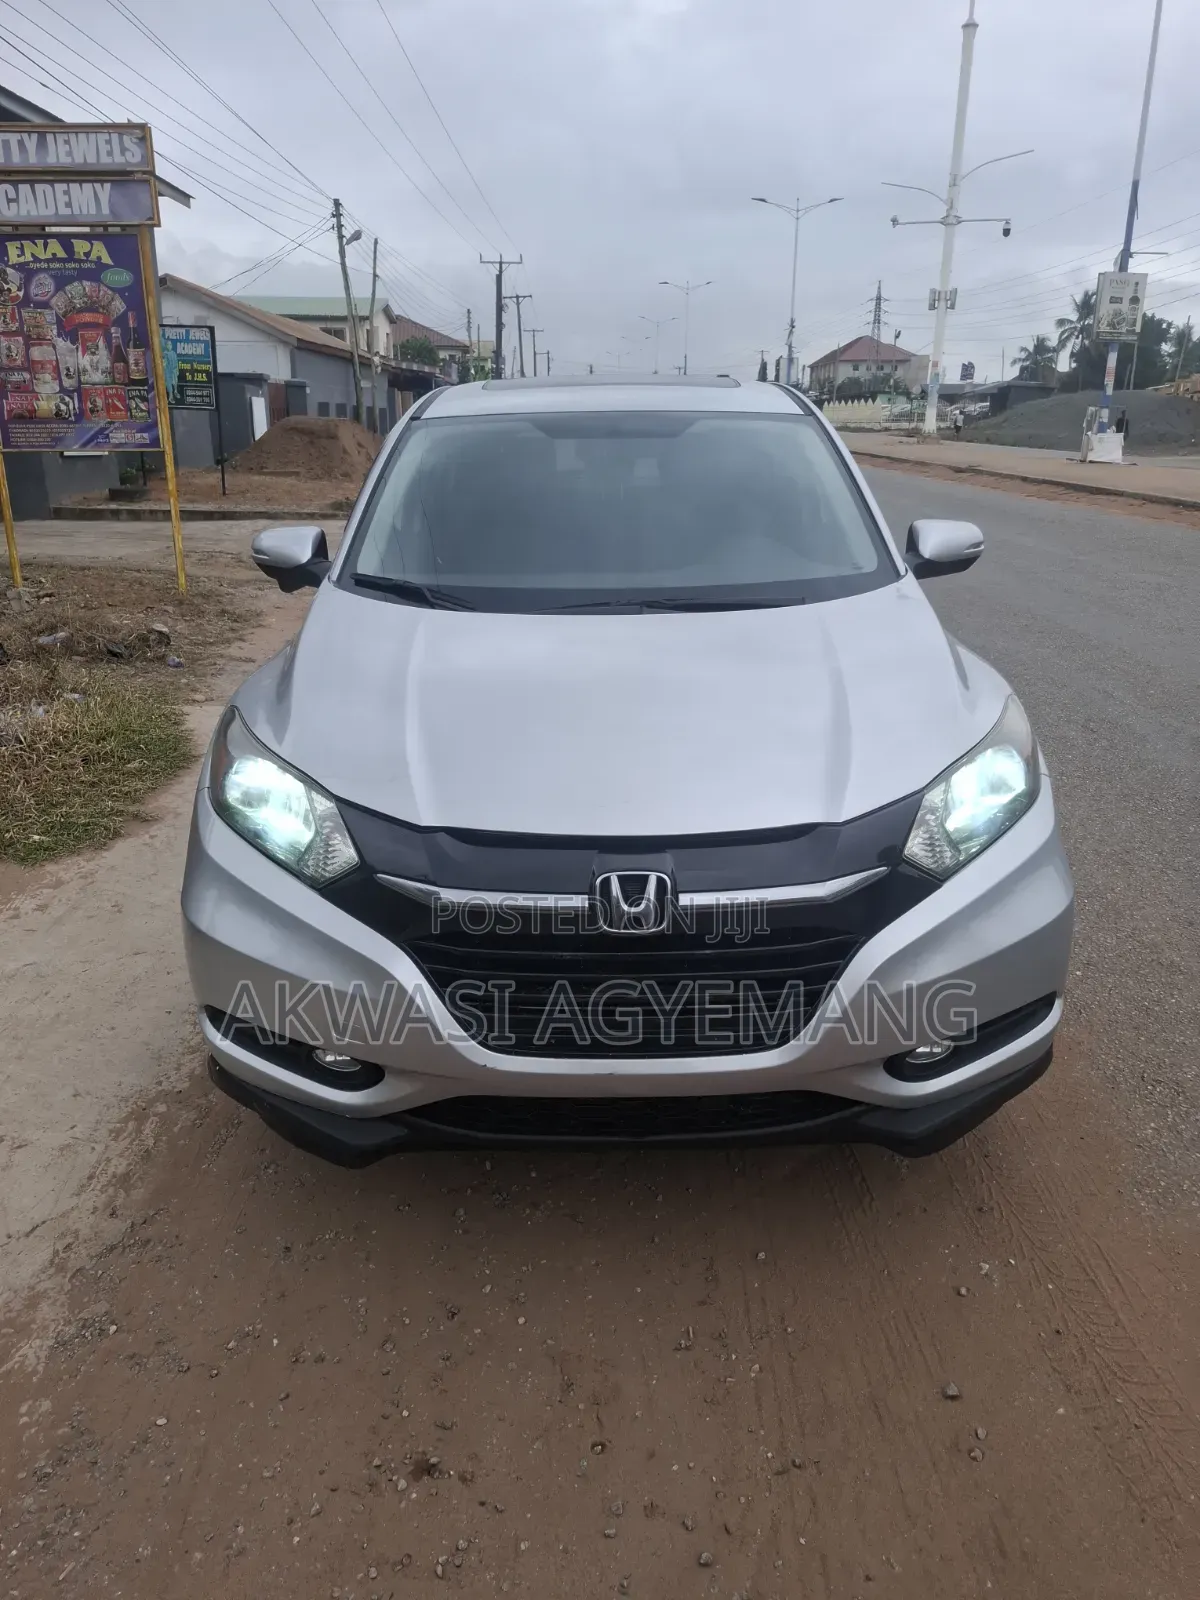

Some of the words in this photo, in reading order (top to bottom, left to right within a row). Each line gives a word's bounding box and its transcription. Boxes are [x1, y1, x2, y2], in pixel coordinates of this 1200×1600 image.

[46, 132, 142, 164] JEWELS
[0, 183, 112, 216] CADEMY
[5, 239, 69, 265] ENA
[71, 238, 114, 265] PA
[177, 342, 205, 355] ACADEMY
[178, 361, 191, 370] From
